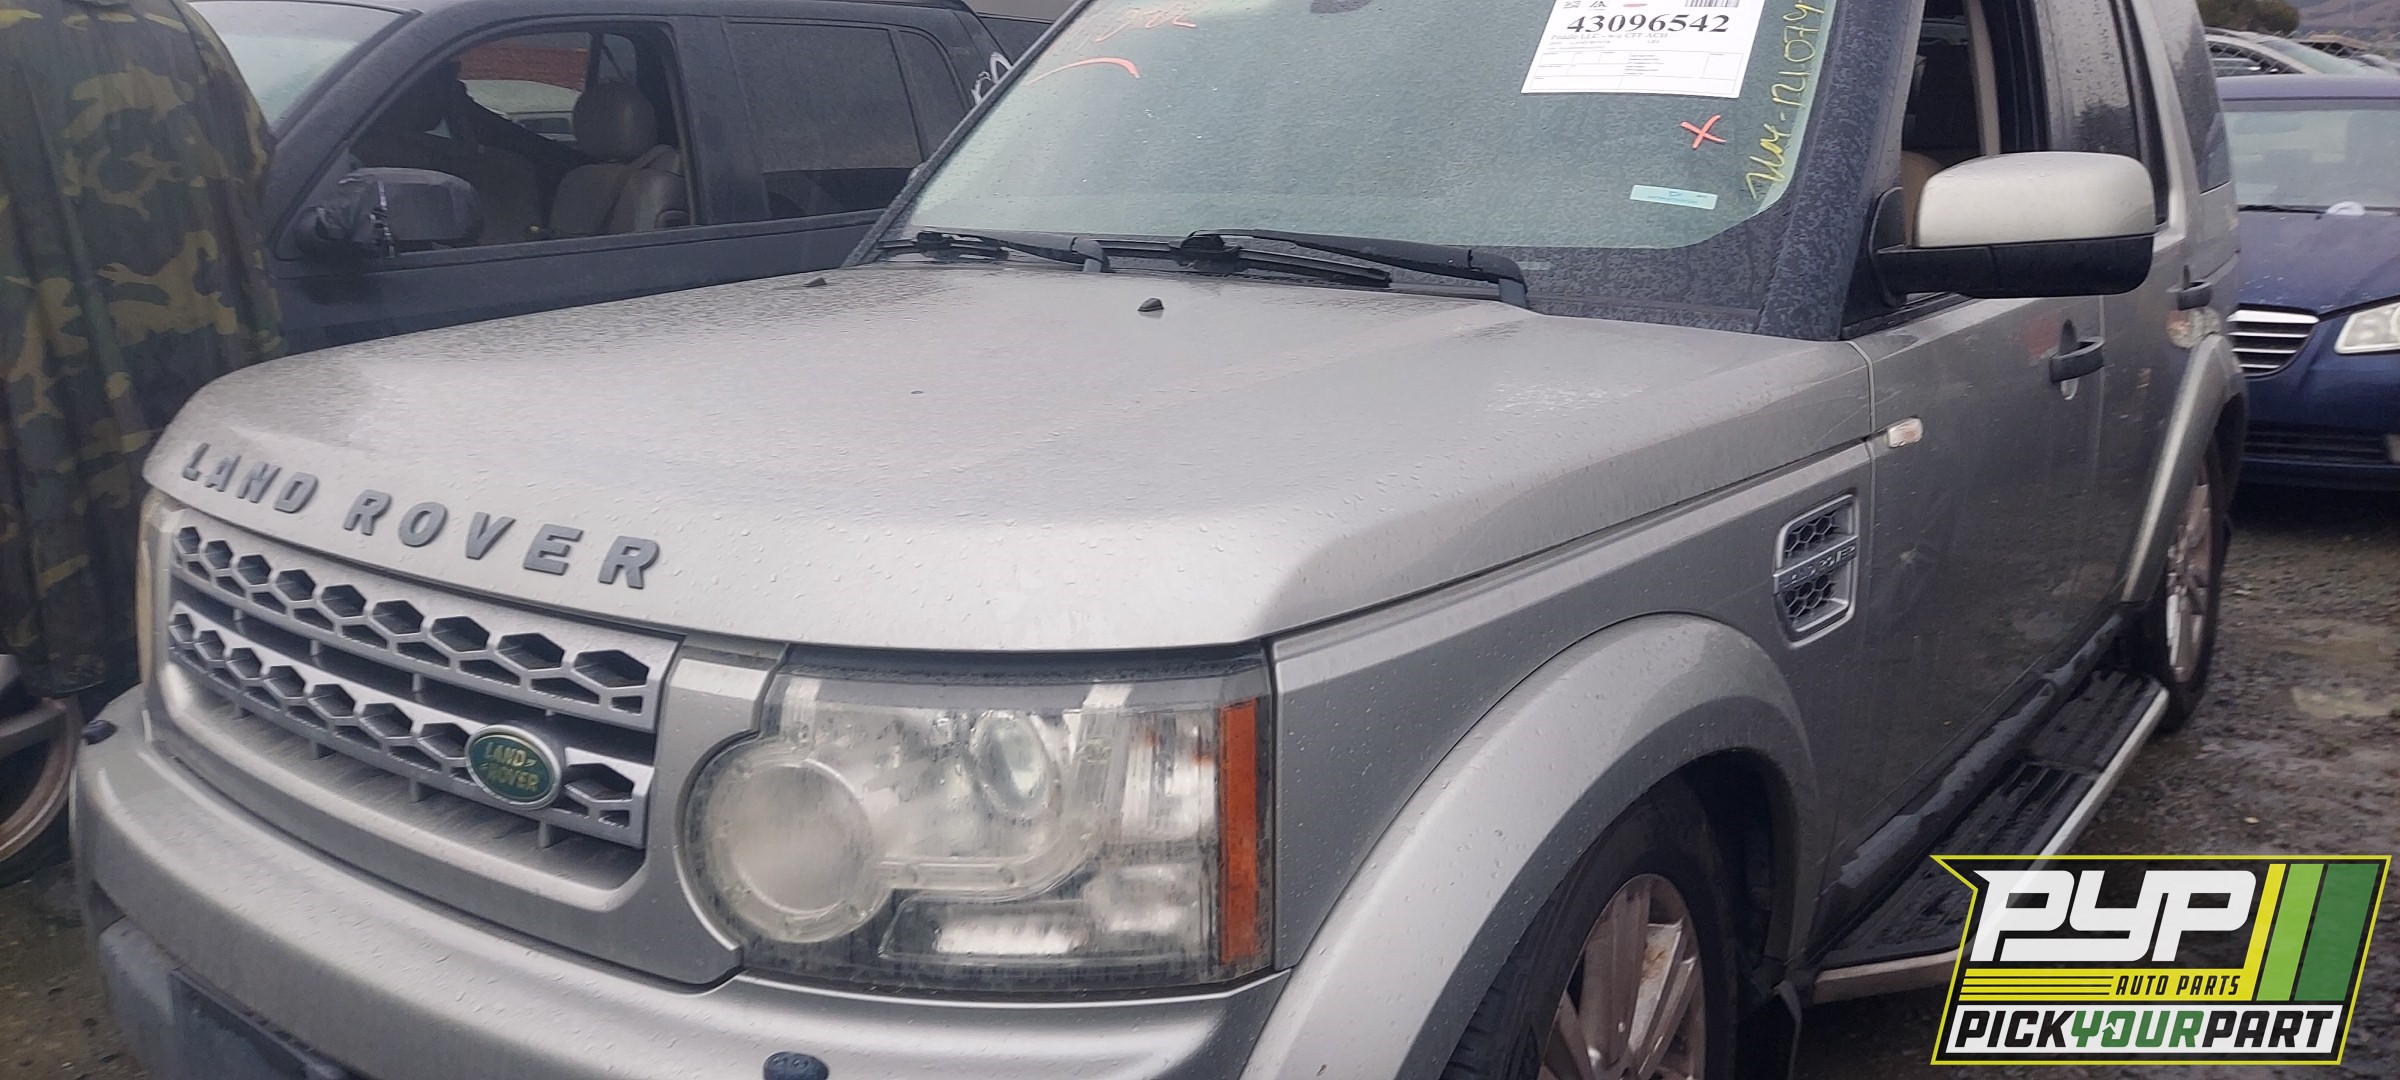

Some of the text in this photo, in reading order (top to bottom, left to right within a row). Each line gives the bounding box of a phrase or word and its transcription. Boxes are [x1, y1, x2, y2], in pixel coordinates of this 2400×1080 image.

[1566, 13, 1731, 34] 43096542
[181, 442, 661, 590] LAND ROVER
[484, 741, 527, 767] LAND
